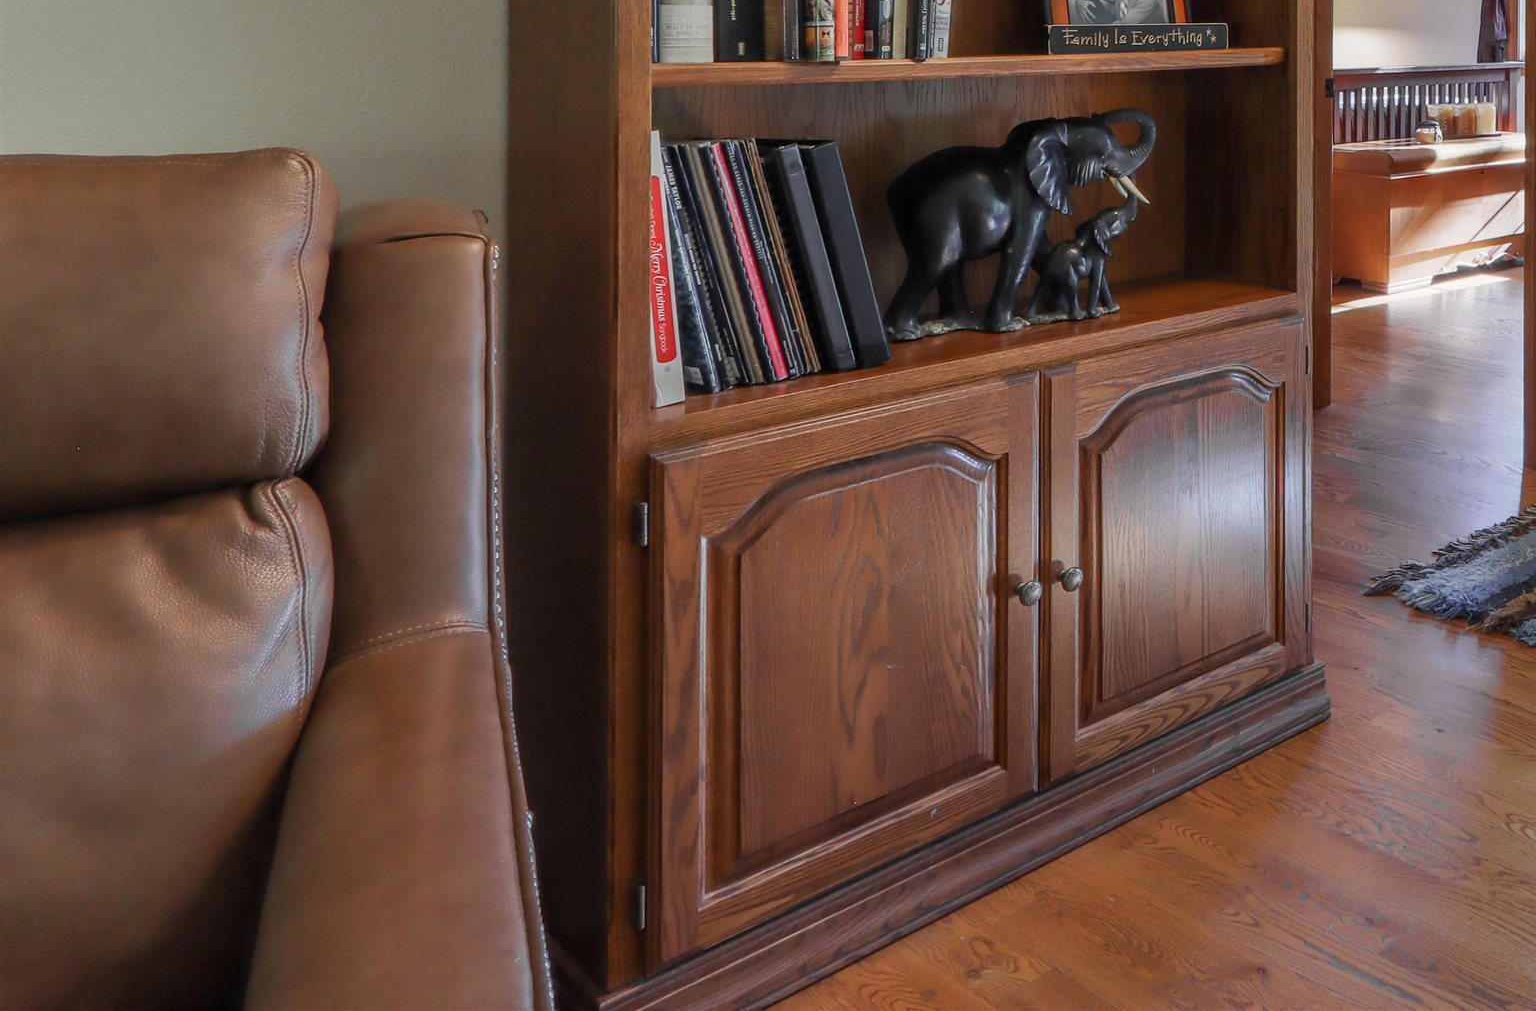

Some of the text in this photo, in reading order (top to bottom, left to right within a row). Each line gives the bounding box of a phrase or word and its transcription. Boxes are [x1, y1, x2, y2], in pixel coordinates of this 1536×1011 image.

[1061, 27, 1203, 48] Family Is Everything
[665, 165, 677, 185] JAMES
[671, 187, 682, 210] TAYLOR
[650, 240, 664, 275] Merry
[651, 274, 668, 322] Christmas
[657, 323, 668, 354] Songbook
